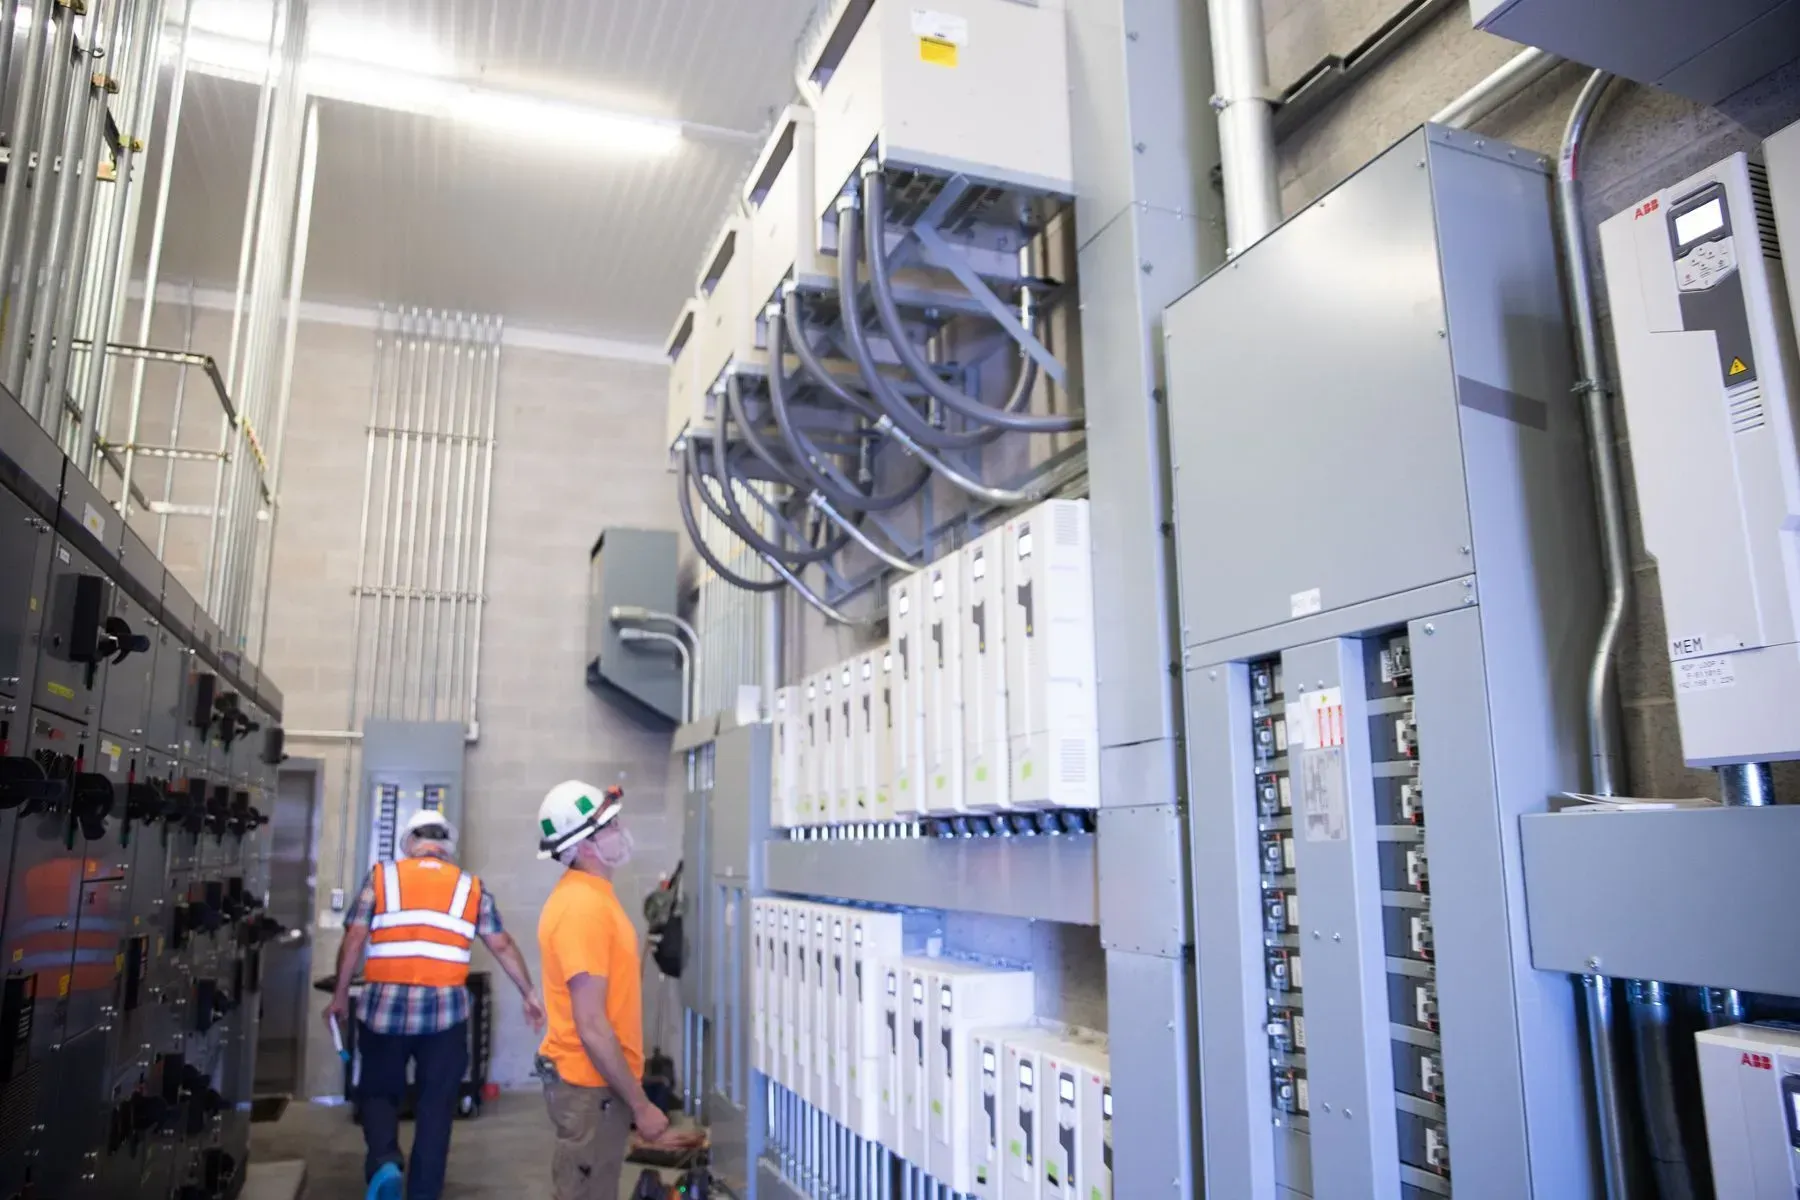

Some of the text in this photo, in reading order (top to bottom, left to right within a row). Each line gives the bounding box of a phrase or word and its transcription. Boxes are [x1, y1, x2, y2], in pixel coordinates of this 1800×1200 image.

[1634, 198, 1659, 220] ABB
[1673, 637, 1703, 655] MEM
[1741, 1052, 1772, 1070] ABB
